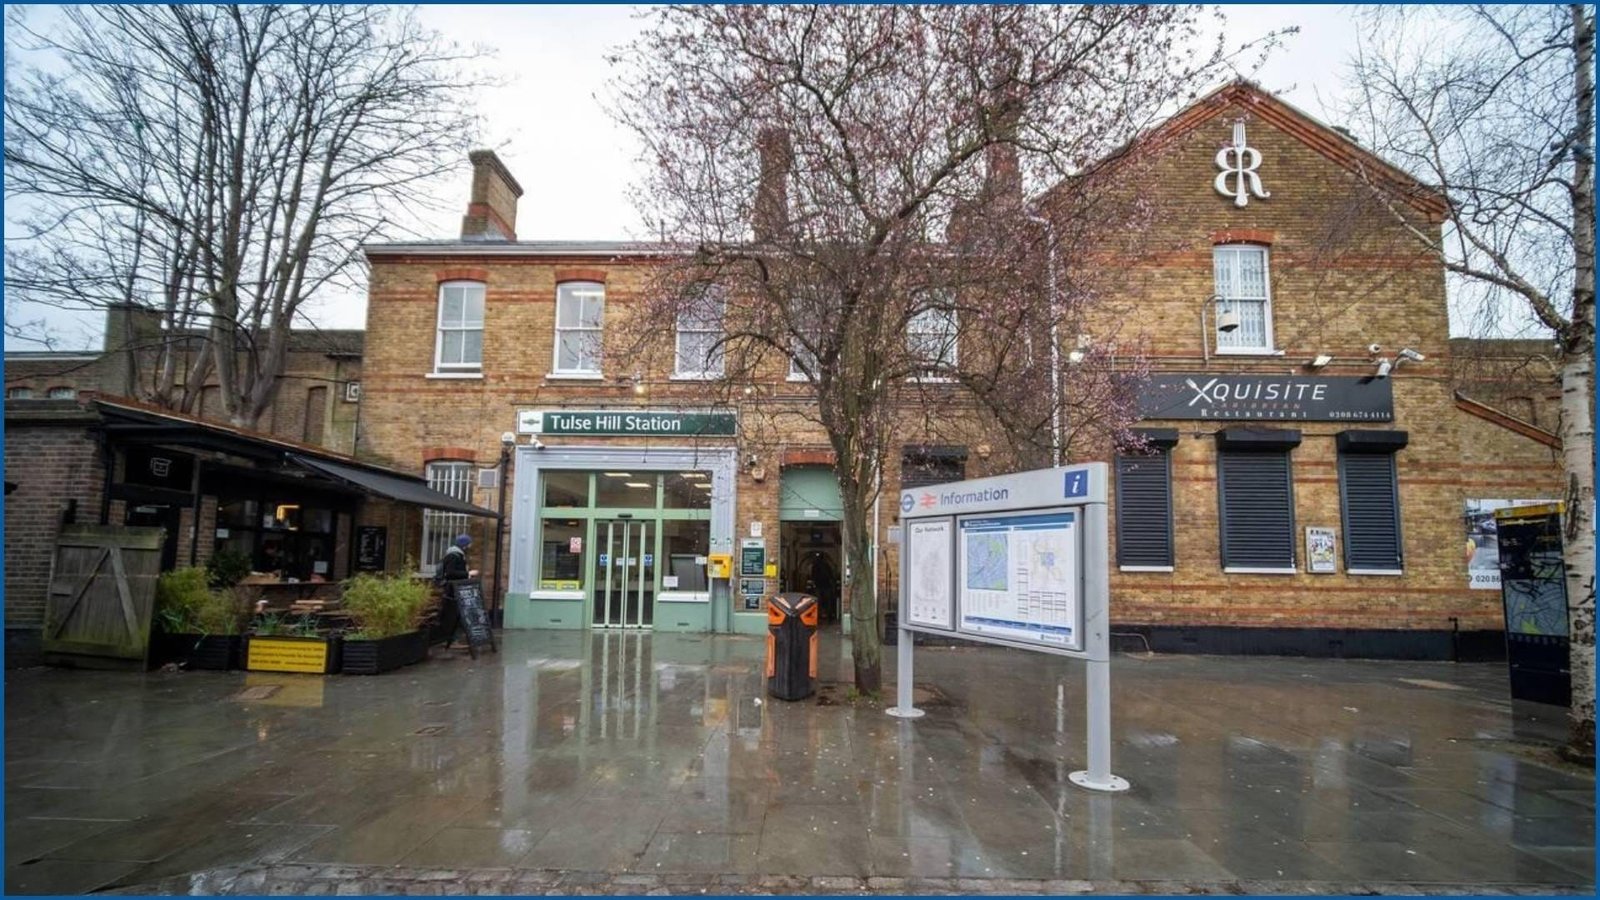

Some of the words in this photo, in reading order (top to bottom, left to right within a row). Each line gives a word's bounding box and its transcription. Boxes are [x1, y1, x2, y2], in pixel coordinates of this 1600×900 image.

[1201, 408, 1308, 418] Restaurant
[551, 415, 591, 430] Tulse
[595, 415, 621, 430] Hill
[625, 415, 681, 431] Station
[940, 488, 1009, 506] Information
